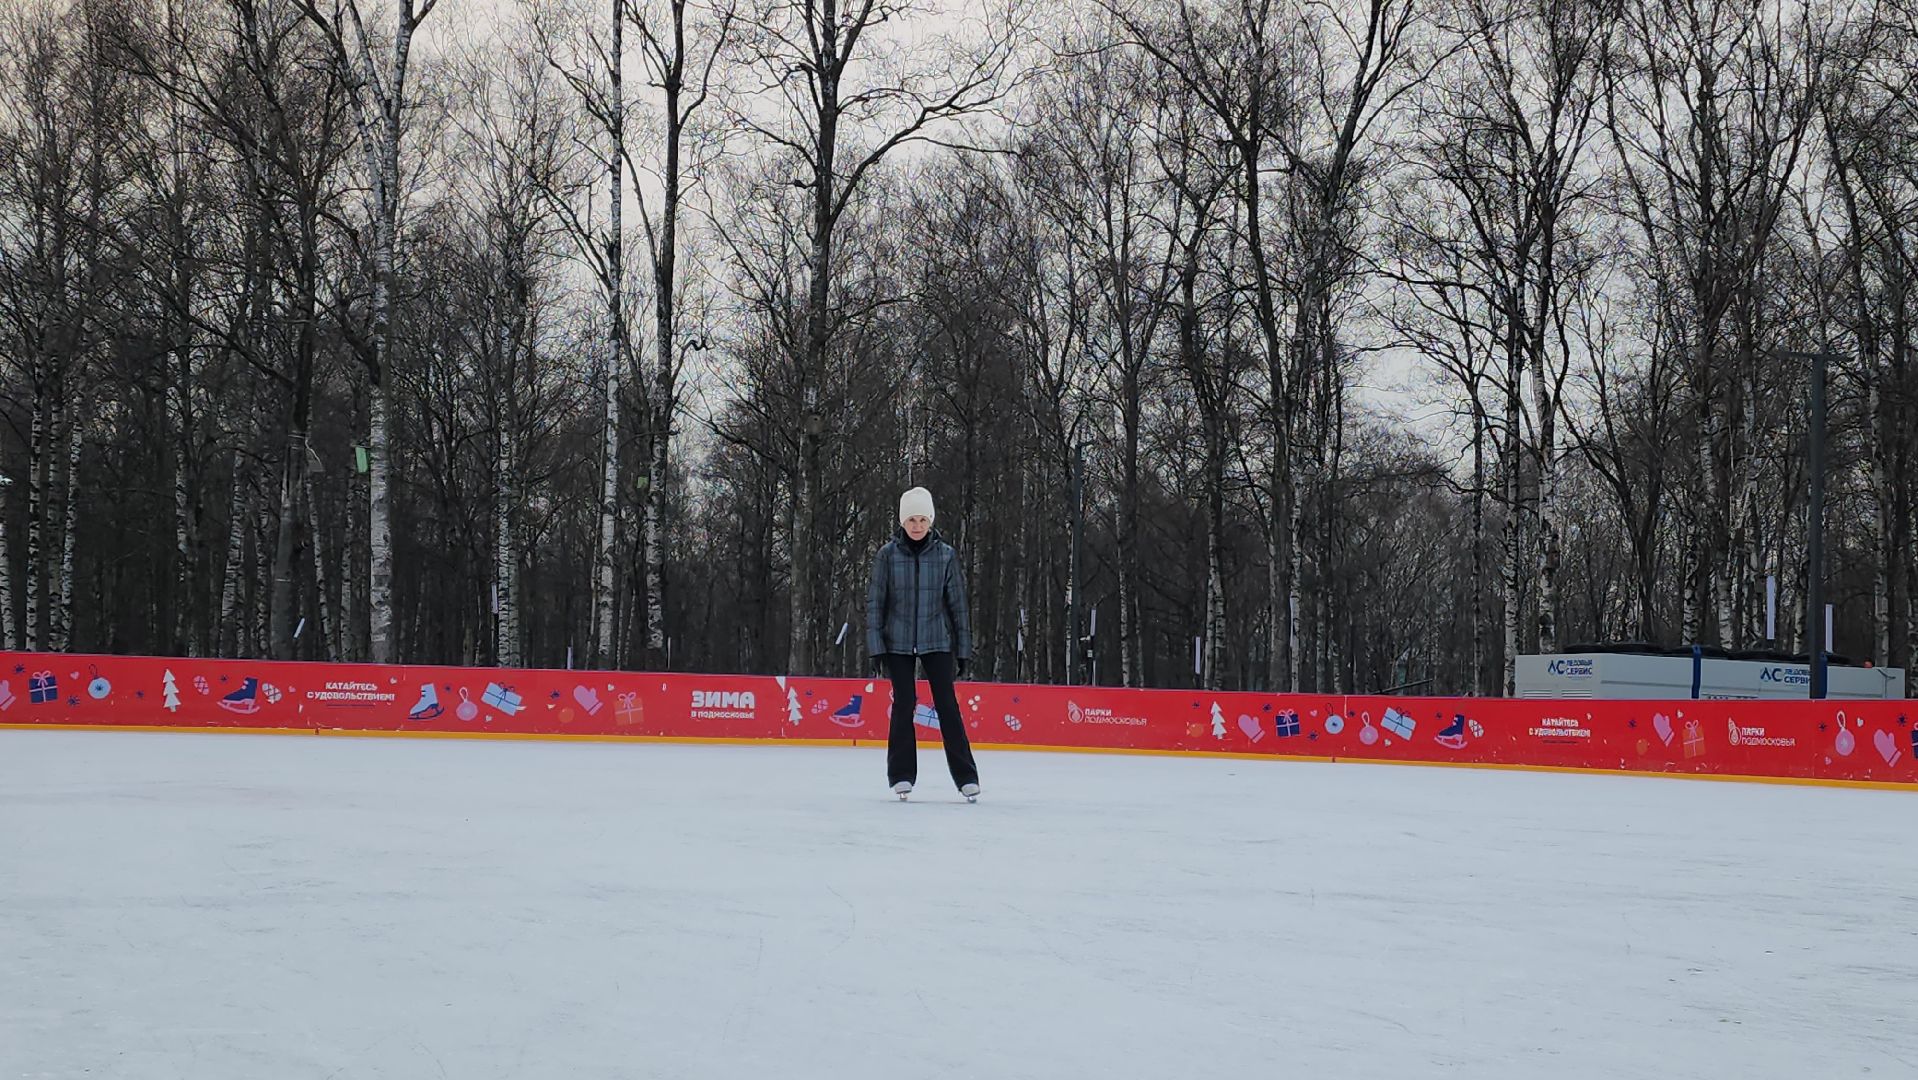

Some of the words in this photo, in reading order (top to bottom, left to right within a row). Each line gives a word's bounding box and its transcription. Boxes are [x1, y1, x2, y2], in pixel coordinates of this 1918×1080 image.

[1567, 667, 1593, 675] СЕРВИС
[325, 681, 378, 691] КАТАЙТЕСЬ
[306, 691, 315, 699] С
[315, 691, 396, 701] УДОВОЛЬСТВИЕМ!
[691, 690, 755, 709] ЗИМА
[1084, 708, 1112, 716] ПАРКИ
[1084, 716, 1147, 726] ПОДМОСКОВЬЯ
[1541, 717, 1579, 727] КАТАЙТЕСЬ
[1741, 727, 1765, 737] ПАРКИ
[1741, 737, 1796, 747] ПОДМОСКОВЬЯ
